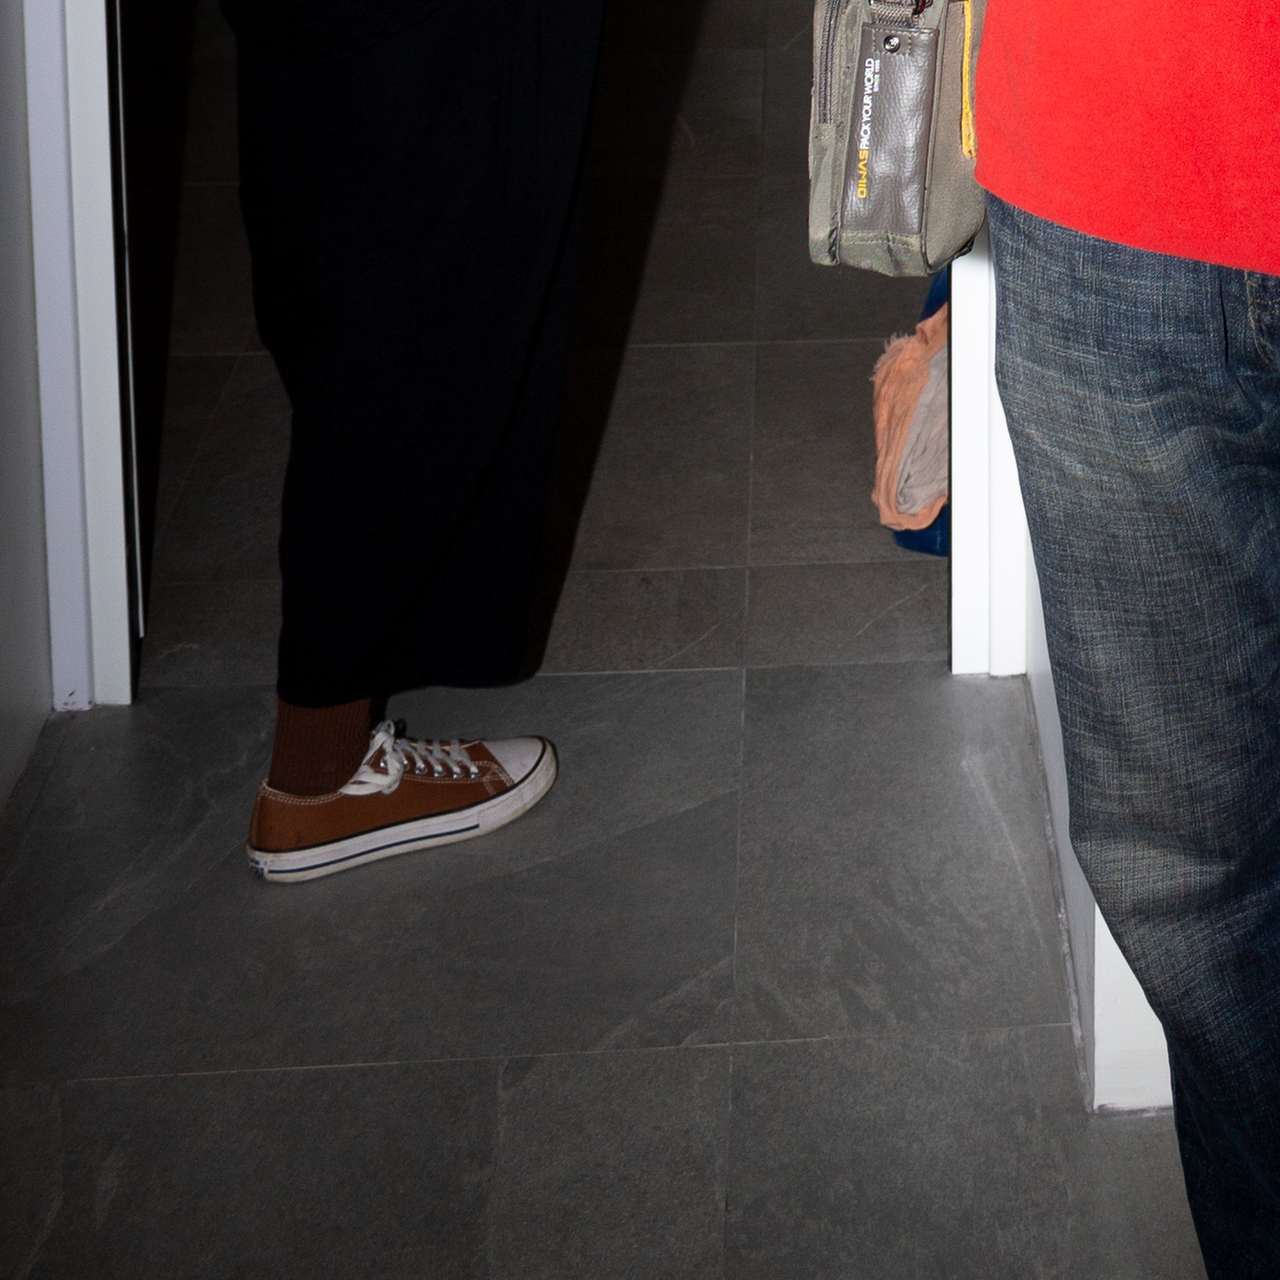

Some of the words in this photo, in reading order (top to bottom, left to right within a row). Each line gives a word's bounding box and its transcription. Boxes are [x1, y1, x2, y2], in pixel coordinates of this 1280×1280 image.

[864, 57, 875, 95] WORLD
[862, 95, 873, 122] YOUR
[860, 122, 872, 150] PACK
